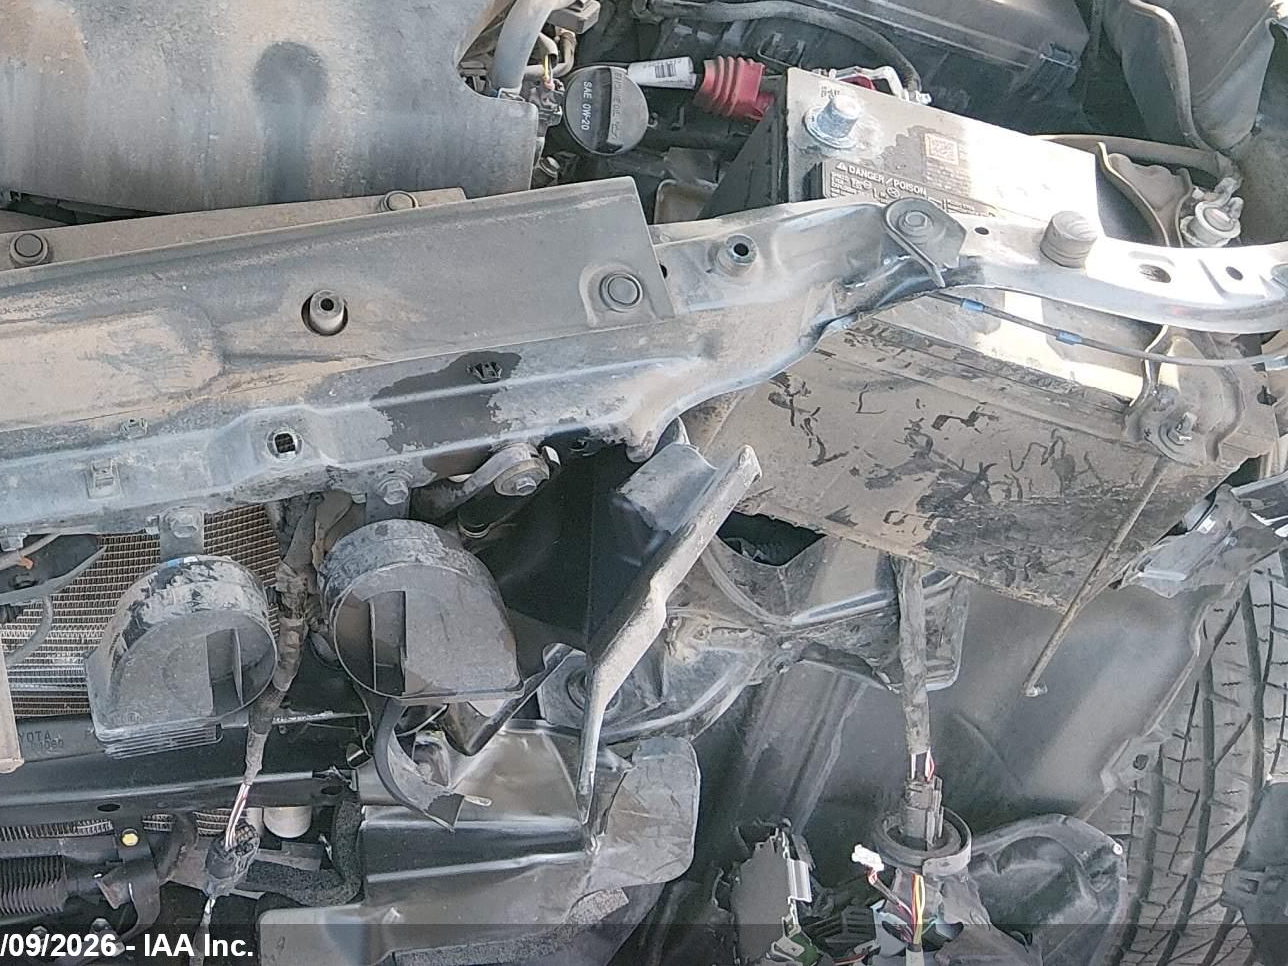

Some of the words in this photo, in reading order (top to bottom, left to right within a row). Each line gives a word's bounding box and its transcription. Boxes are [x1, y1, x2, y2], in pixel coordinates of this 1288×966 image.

[583, 81, 592, 99] SAE
[581, 103, 592, 131] 0W-20
[848, 165, 885, 185] DANGER
[893, 178, 928, 196] POISON
